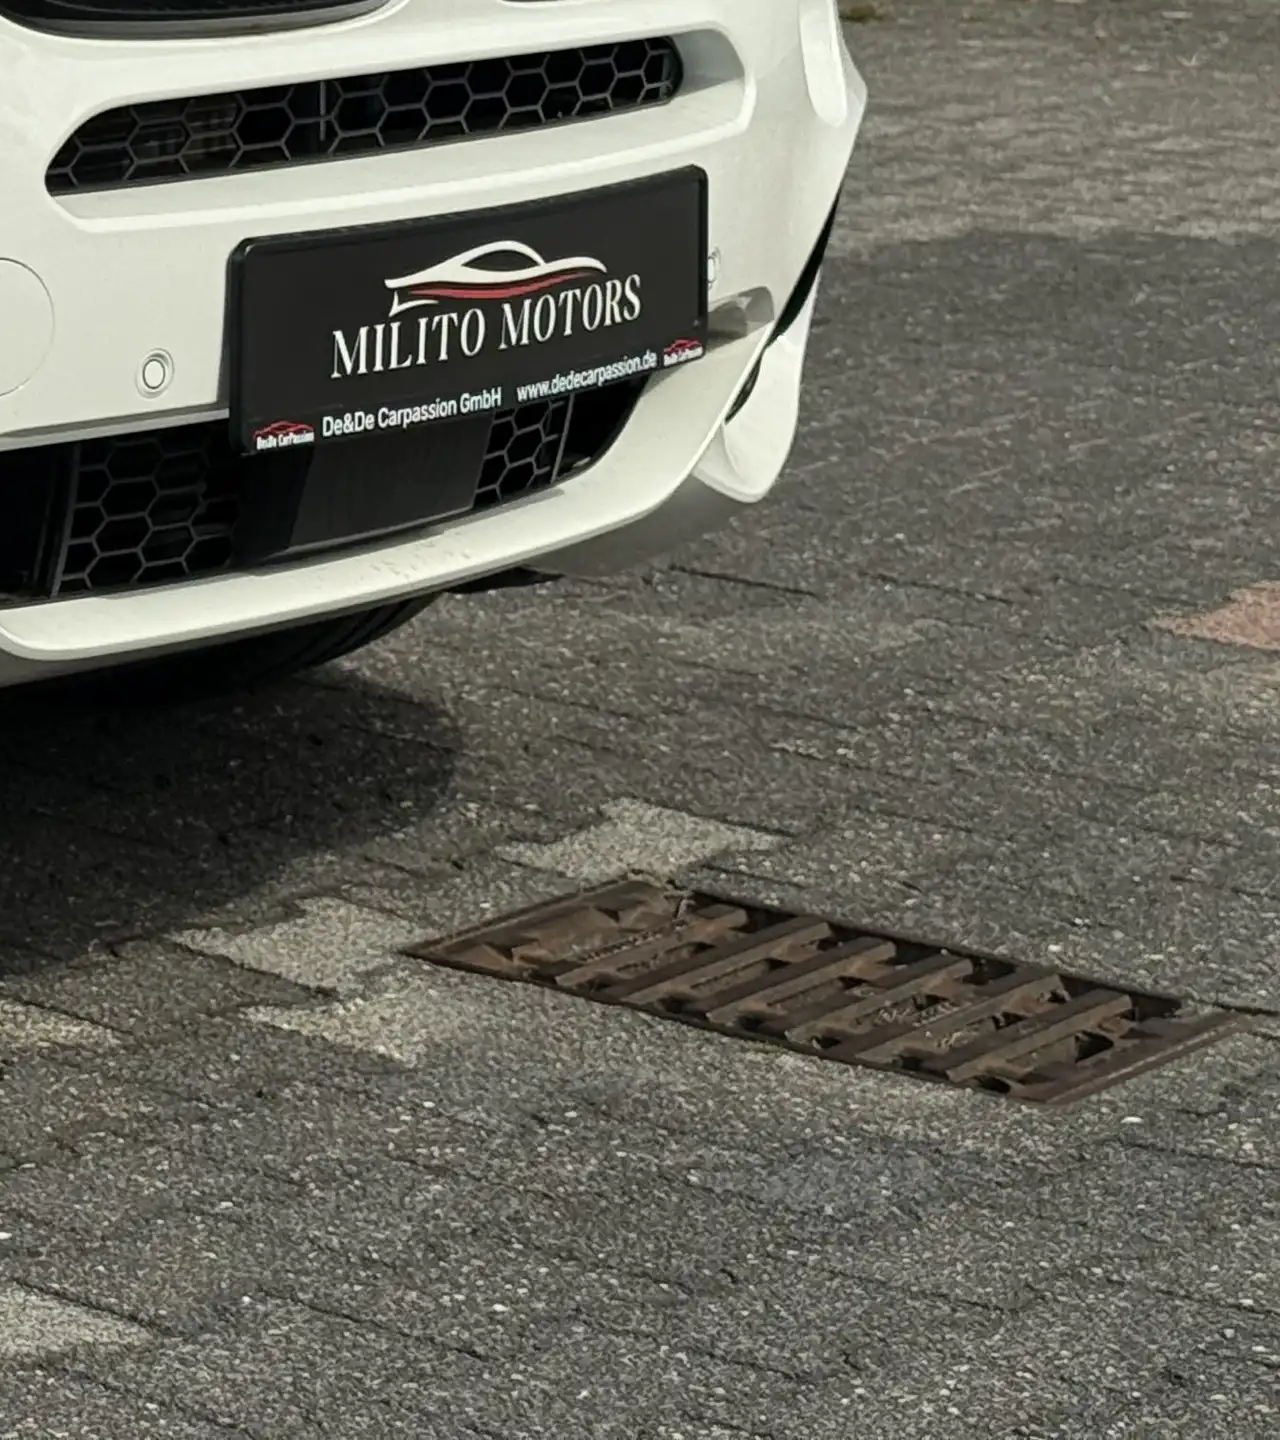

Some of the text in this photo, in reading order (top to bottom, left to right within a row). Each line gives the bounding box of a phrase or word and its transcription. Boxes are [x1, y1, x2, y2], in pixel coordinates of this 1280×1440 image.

[331, 273, 641, 379] MILITO MOTORS
[322, 412, 375, 437] De&De
[377, 397, 458, 429] Carpassion
[459, 386, 503, 414] GmbH
[516, 348, 658, 403] www.dedecarpassion.de
